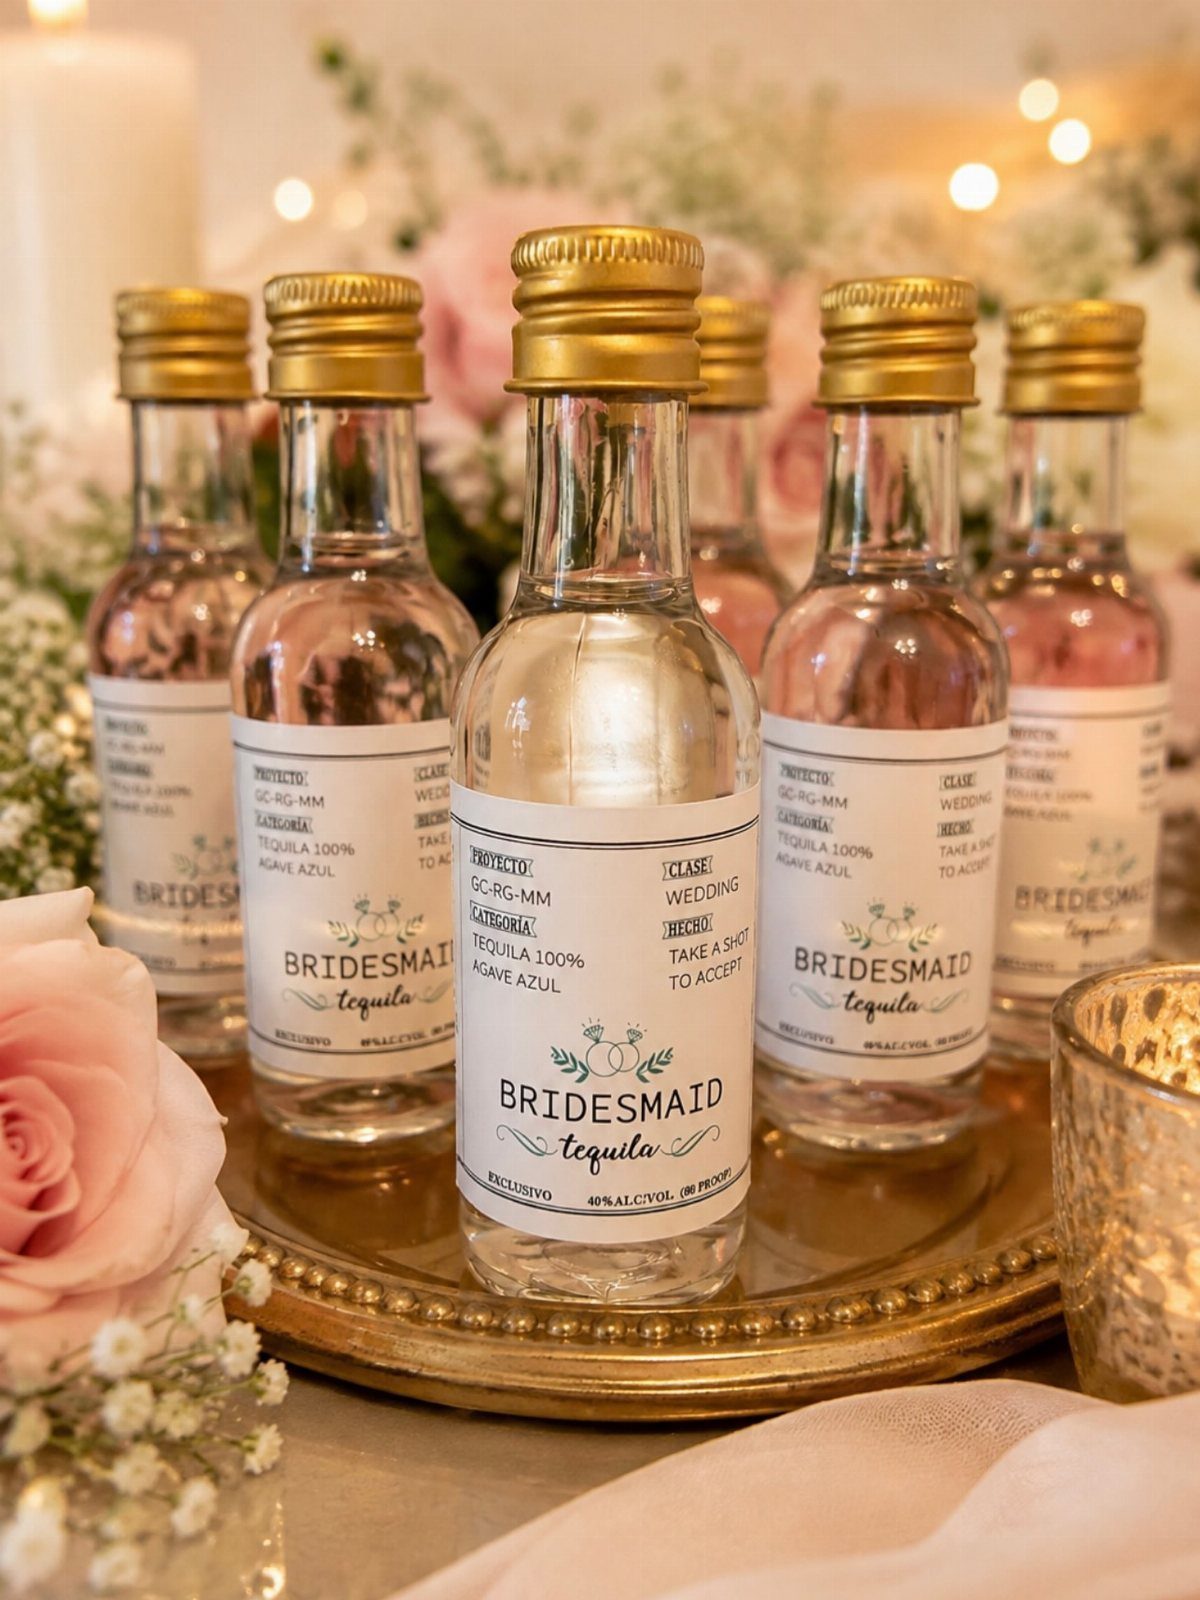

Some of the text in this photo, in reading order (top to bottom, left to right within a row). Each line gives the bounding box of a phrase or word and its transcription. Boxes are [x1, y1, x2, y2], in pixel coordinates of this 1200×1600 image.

[415, 784, 450, 802] WEDD
[258, 835, 355, 856] TEQUILA 100%
[778, 830, 873, 860] TEQUILA 100%
[259, 857, 336, 878] AGAVE AZUL
[418, 856, 435, 870] TO
[472, 848, 527, 875] PROYECTO
[669, 858, 708, 877] CLASE
[776, 851, 852, 878] AGAVE AZUL
[133, 880, 240, 909] BRIDES
[471, 875, 551, 907] GC-RG-MM
[666, 876, 739, 905] WEDDING
[472, 906, 531, 935] CATEGORÍA
[668, 916, 709, 937] HECHO
[285, 940, 454, 979] BRIDESMAI
[473, 933, 585, 969] TEQUILA 100%
[669, 927, 750, 964] TAKE A SHOT
[473, 959, 561, 994] AGAVE AZUL
[669, 957, 742, 990] TO ACCEPT
[795, 946, 972, 984] BRIDESMAID
[336, 984, 414, 1021] tequila
[843, 989, 922, 1024] tequila
[500, 1078, 722, 1123] BRIDESMAID
[559, 1133, 661, 1175] tequila
[488, 1171, 552, 1201] EXCLUSIVO
